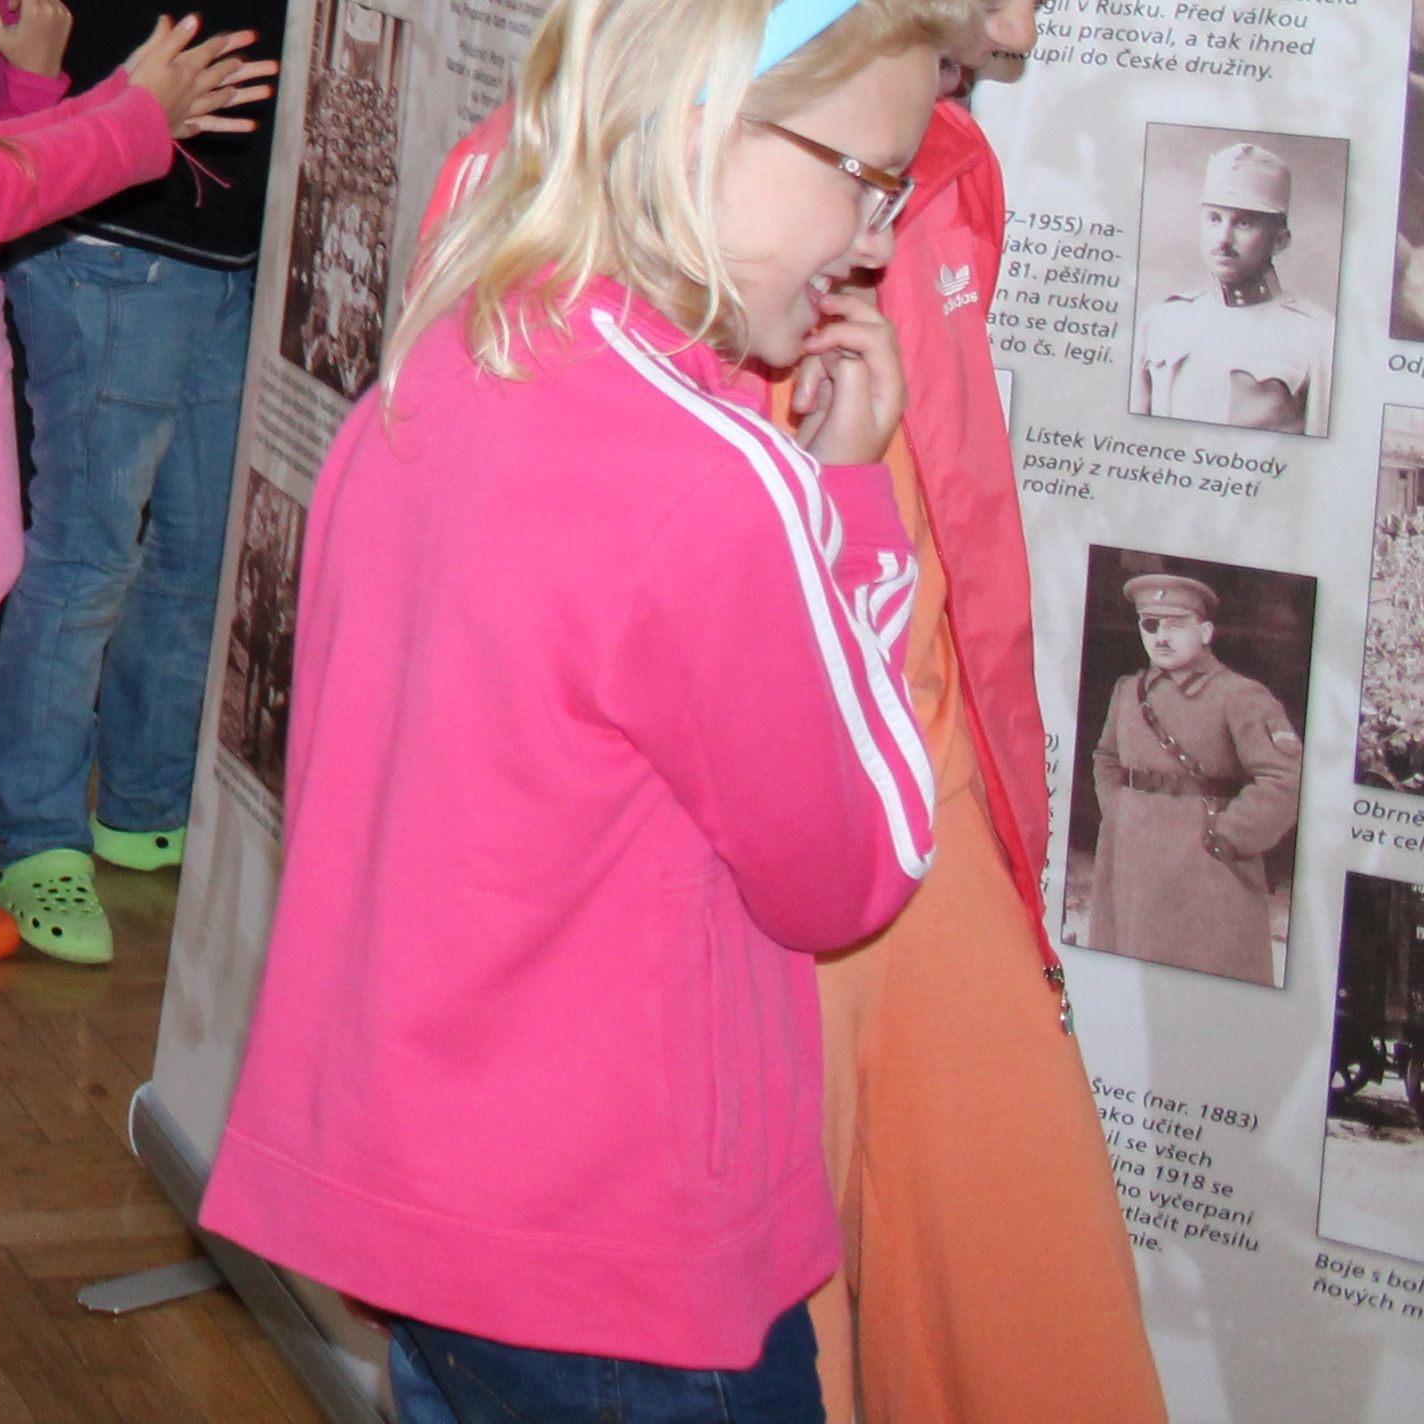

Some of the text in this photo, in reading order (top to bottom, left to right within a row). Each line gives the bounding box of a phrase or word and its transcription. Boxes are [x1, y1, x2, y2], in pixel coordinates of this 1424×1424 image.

[1174, 2, 1226, 22] Před
[1232, 7, 1308, 28] válkou
[1078, 26, 1316, 56] pracoval, tak ihned
[1116, 48, 1272, 82] České družiny.
[1050, 240, 1122, 263] jedno-
[1008, 260, 1120, 288] 81. pěšímu
[1047, 292, 1118, 314] ruskou
[1053, 314, 1118, 339] dostal
[1033, 338, 1114, 366] čs. legií.
[1026, 426, 1288, 479] Lístek Vincence Svobody
[1022, 454, 1262, 498] psaný ruského zajetí
[1022, 478, 1094, 500] rodině.
[1351, 826, 1387, 845] vat
[1144, 1090, 1188, 1116] (nar.
[1201, 1104, 1258, 1133] 1883)
[1142, 1118, 1204, 1142] učitel
[1156, 1142, 1212, 1168] všech
[1156, 1165, 1206, 1190] 1918
[1184, 1224, 1259, 1253] přesilu
